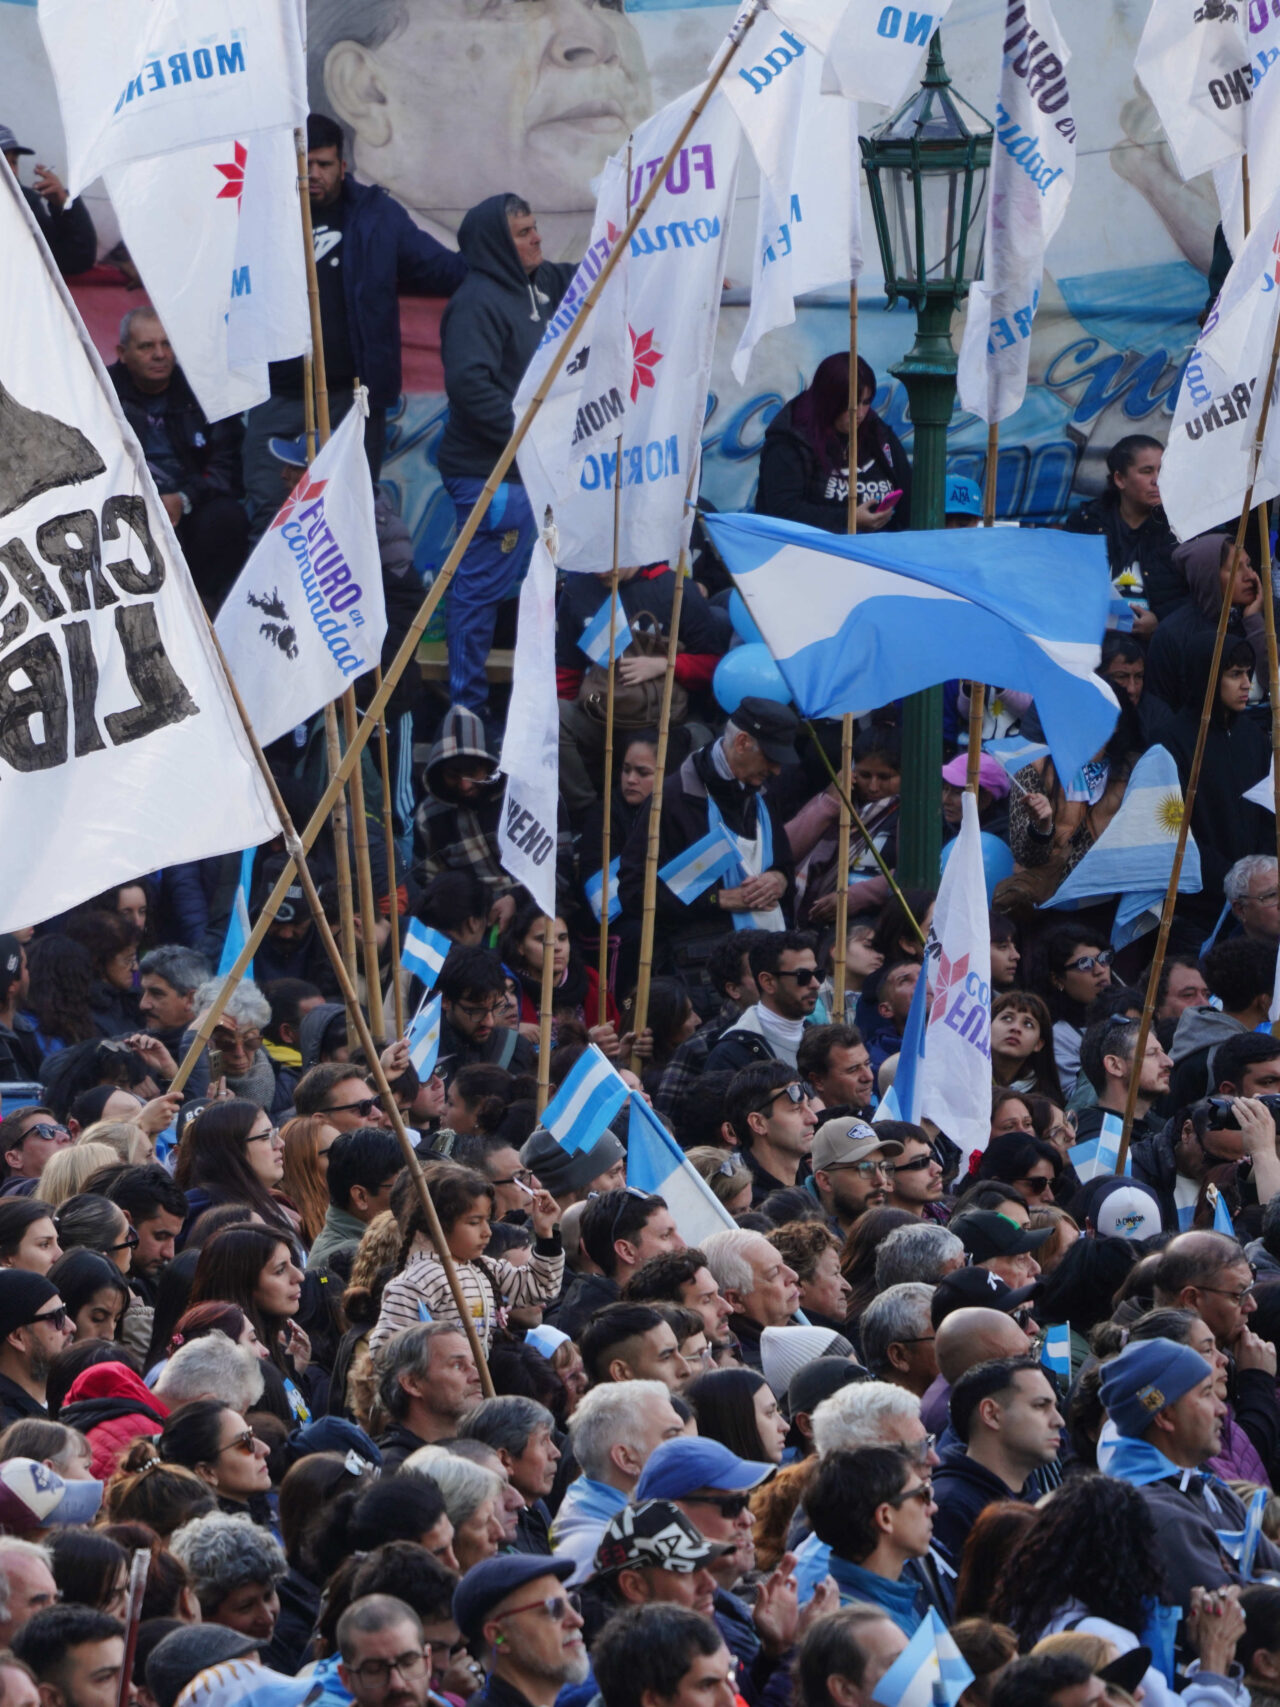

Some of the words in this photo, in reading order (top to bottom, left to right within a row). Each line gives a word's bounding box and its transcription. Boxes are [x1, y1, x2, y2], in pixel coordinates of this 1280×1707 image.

[280, 521, 366, 677] comunidad
[298, 496, 363, 613] FUTURO
[348, 608, 365, 628] en
[507, 793, 555, 867] RENO
